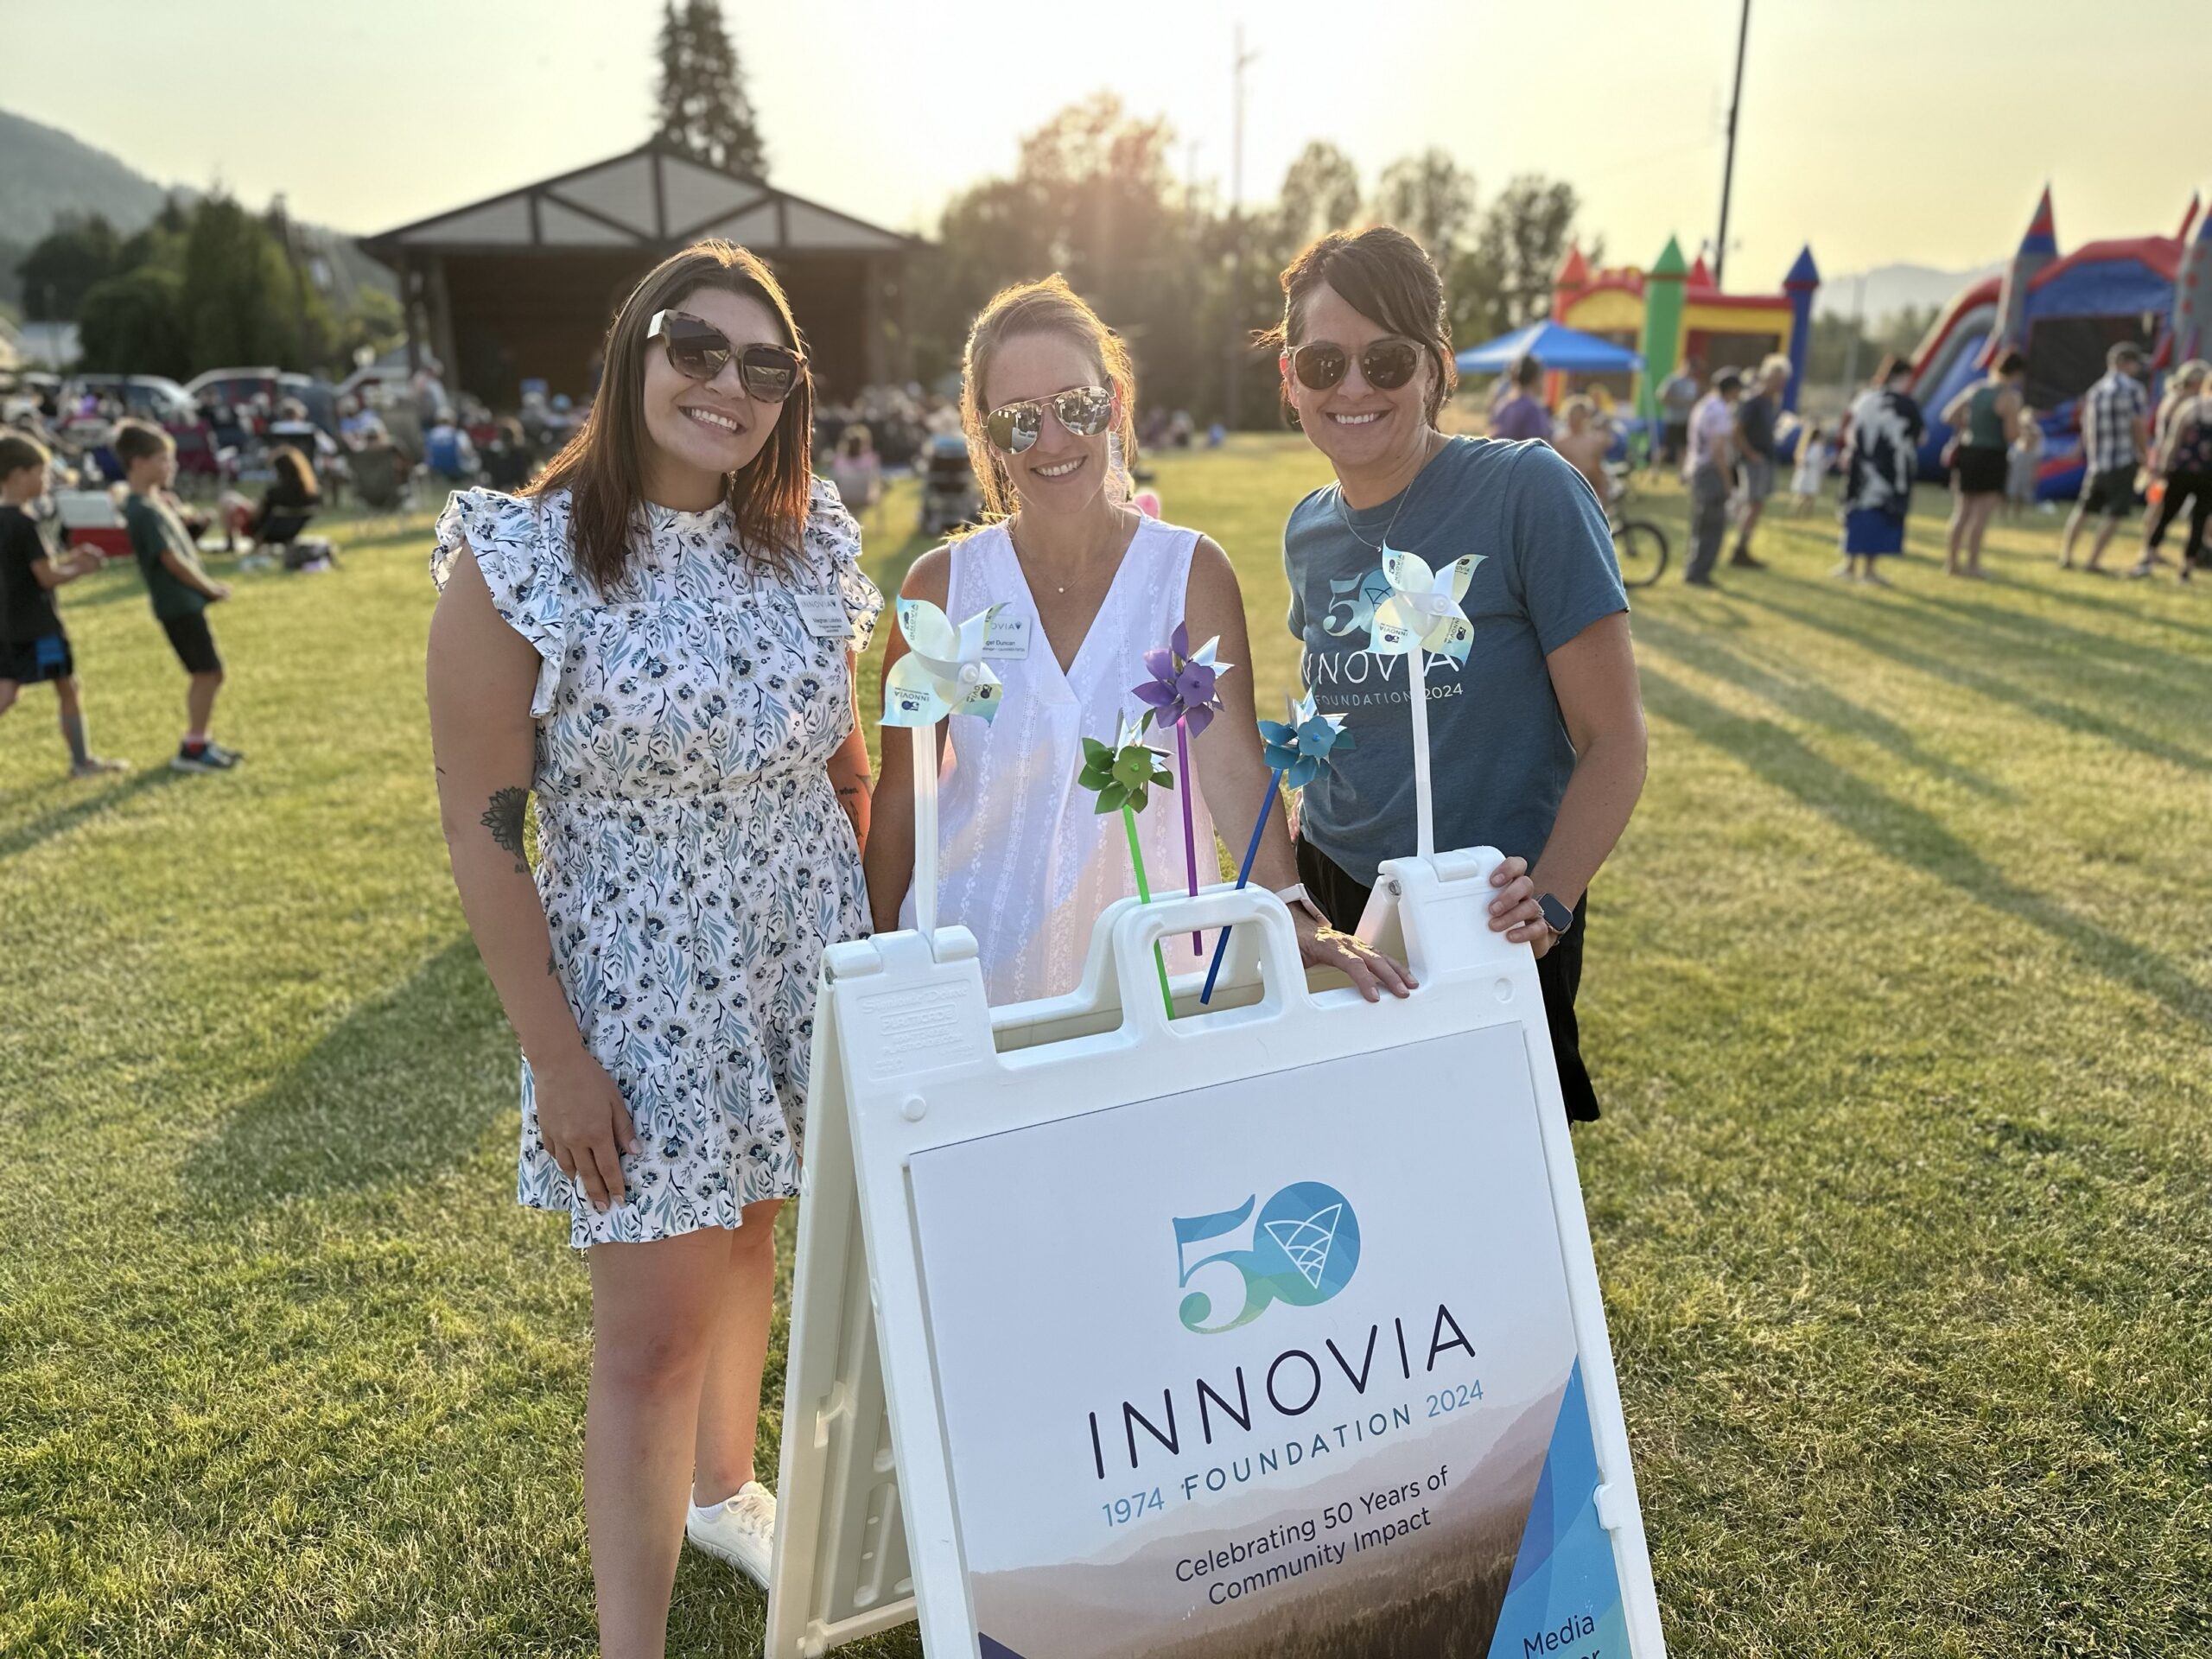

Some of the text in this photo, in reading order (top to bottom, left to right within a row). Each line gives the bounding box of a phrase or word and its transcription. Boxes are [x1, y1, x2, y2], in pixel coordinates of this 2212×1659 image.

[1380, 625, 1408, 636] INNOVIA
[1384, 633, 1399, 644] 50
[1447, 617, 1460, 643] INNOVIA
[1456, 626, 1466, 641] 50
[1301, 650, 1460, 685] NNOVA
[894, 691, 930, 702] INNOVIA
[901, 697, 919, 712] 50
[981, 683, 993, 700] 50
[1315, 683, 1464, 707] FOUNDATION 2024
[1173, 1181, 1361, 1334] 50
[1089, 1304, 1476, 1479] INNOVIA
[1102, 1379, 1484, 1528] 1974 FOUNDATION 2024
[1175, 1465, 1448, 1582] Celebrating 50 Years of
[1209, 1507, 1431, 1605] Community Impact
[1523, 1614, 1595, 1659] Media
